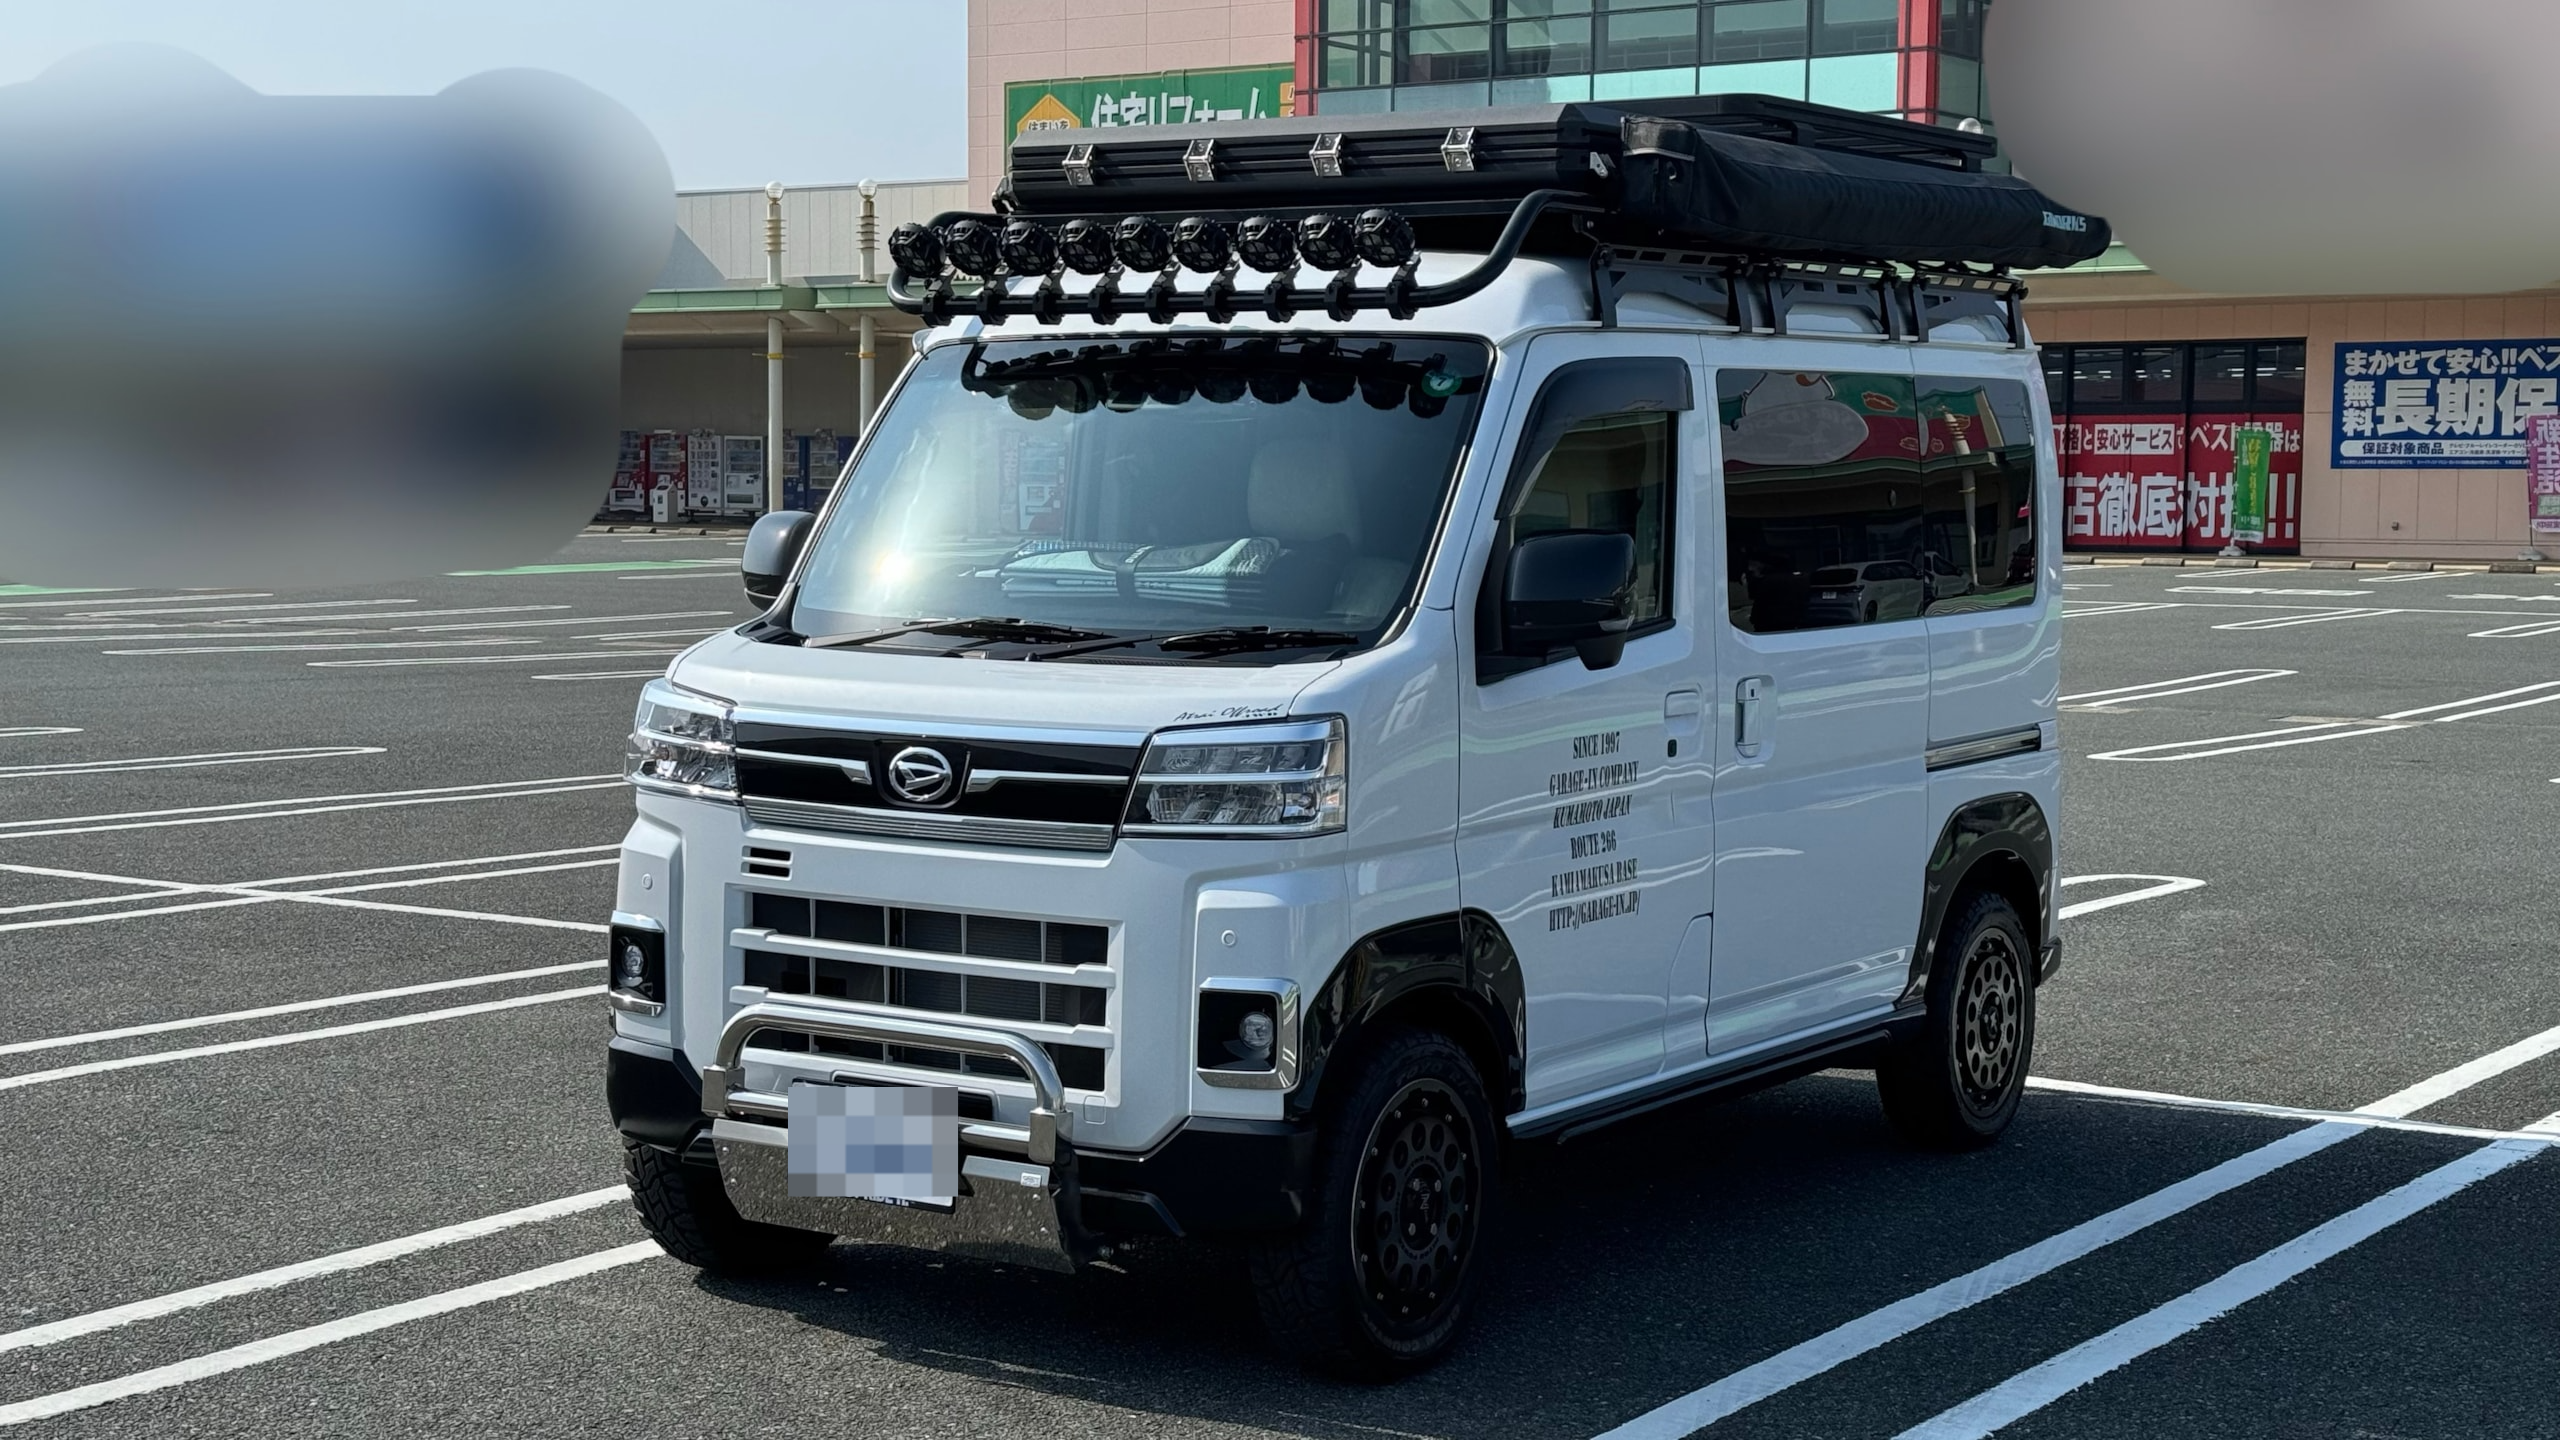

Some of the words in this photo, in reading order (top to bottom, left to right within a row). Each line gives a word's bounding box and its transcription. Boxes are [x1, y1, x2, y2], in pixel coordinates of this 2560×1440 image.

[1437, 376, 1448, 387] 7
[2342, 379, 2375, 437] 無料
[2376, 377, 2560, 436] 長期保
[2362, 442, 2445, 455] 保証対象商品
[1572, 734, 1599, 760] SINCE
[1601, 731, 1621, 756] 1997
[1599, 761, 1640, 788] COMPANY
[1553, 799, 1602, 829] KUMAMOTO
[1603, 794, 1633, 821] JAPAN
[1570, 832, 1600, 860] ROUTE
[1601, 830, 1617, 854] 266
[1551, 863, 1615, 898] KAMIAMAKUSA
[1616, 858, 1638, 883] BASE
